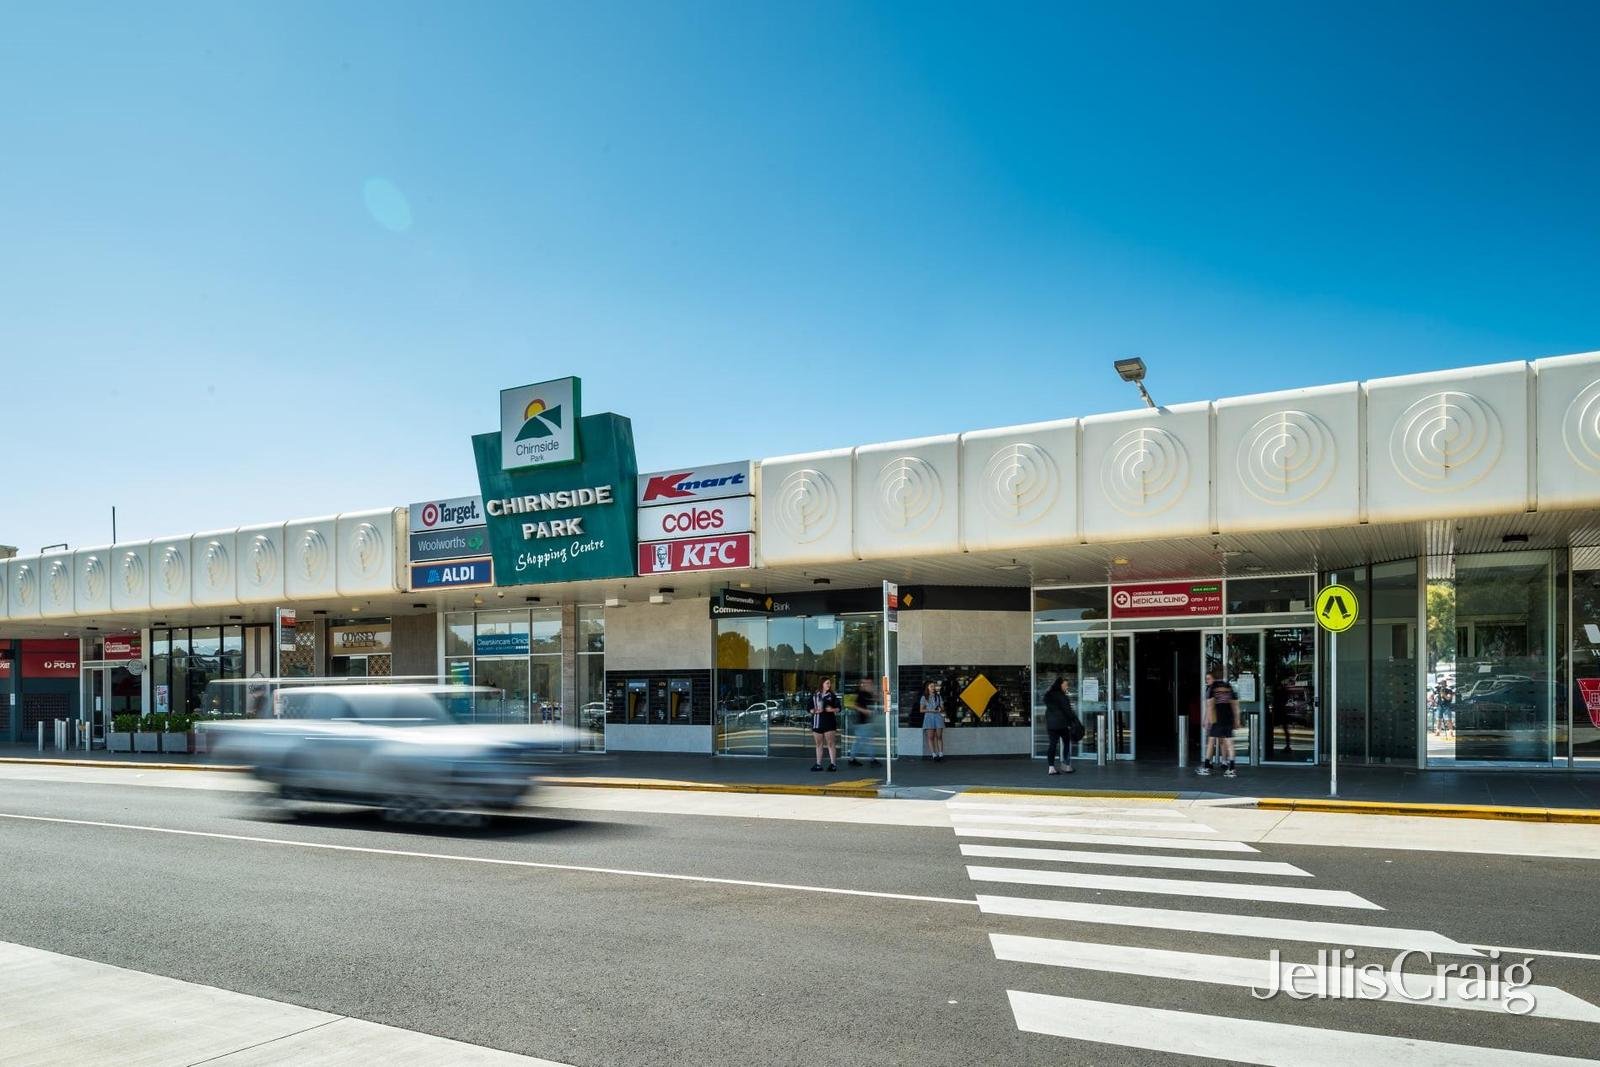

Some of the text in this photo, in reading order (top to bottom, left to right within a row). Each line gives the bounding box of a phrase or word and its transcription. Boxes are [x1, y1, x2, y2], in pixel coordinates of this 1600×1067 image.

[515, 440, 560, 456] Chirnside
[530, 454, 544, 462] Park
[642, 472, 745, 502] Kmart
[486, 484, 614, 517] CHIRNSIDE
[521, 517, 584, 540] PARK
[662, 507, 724, 533] coles
[418, 536, 466, 551] Woolworths
[515, 539, 605, 571] Shopping Centre
[680, 540, 737, 567] KFC
[441, 565, 475, 582] ALDI
[773, 602, 791, 612] Bank
[1133, 595, 1187, 605] MEDICAL CLINIC
[342, 631, 377, 642] ODYSSEY
